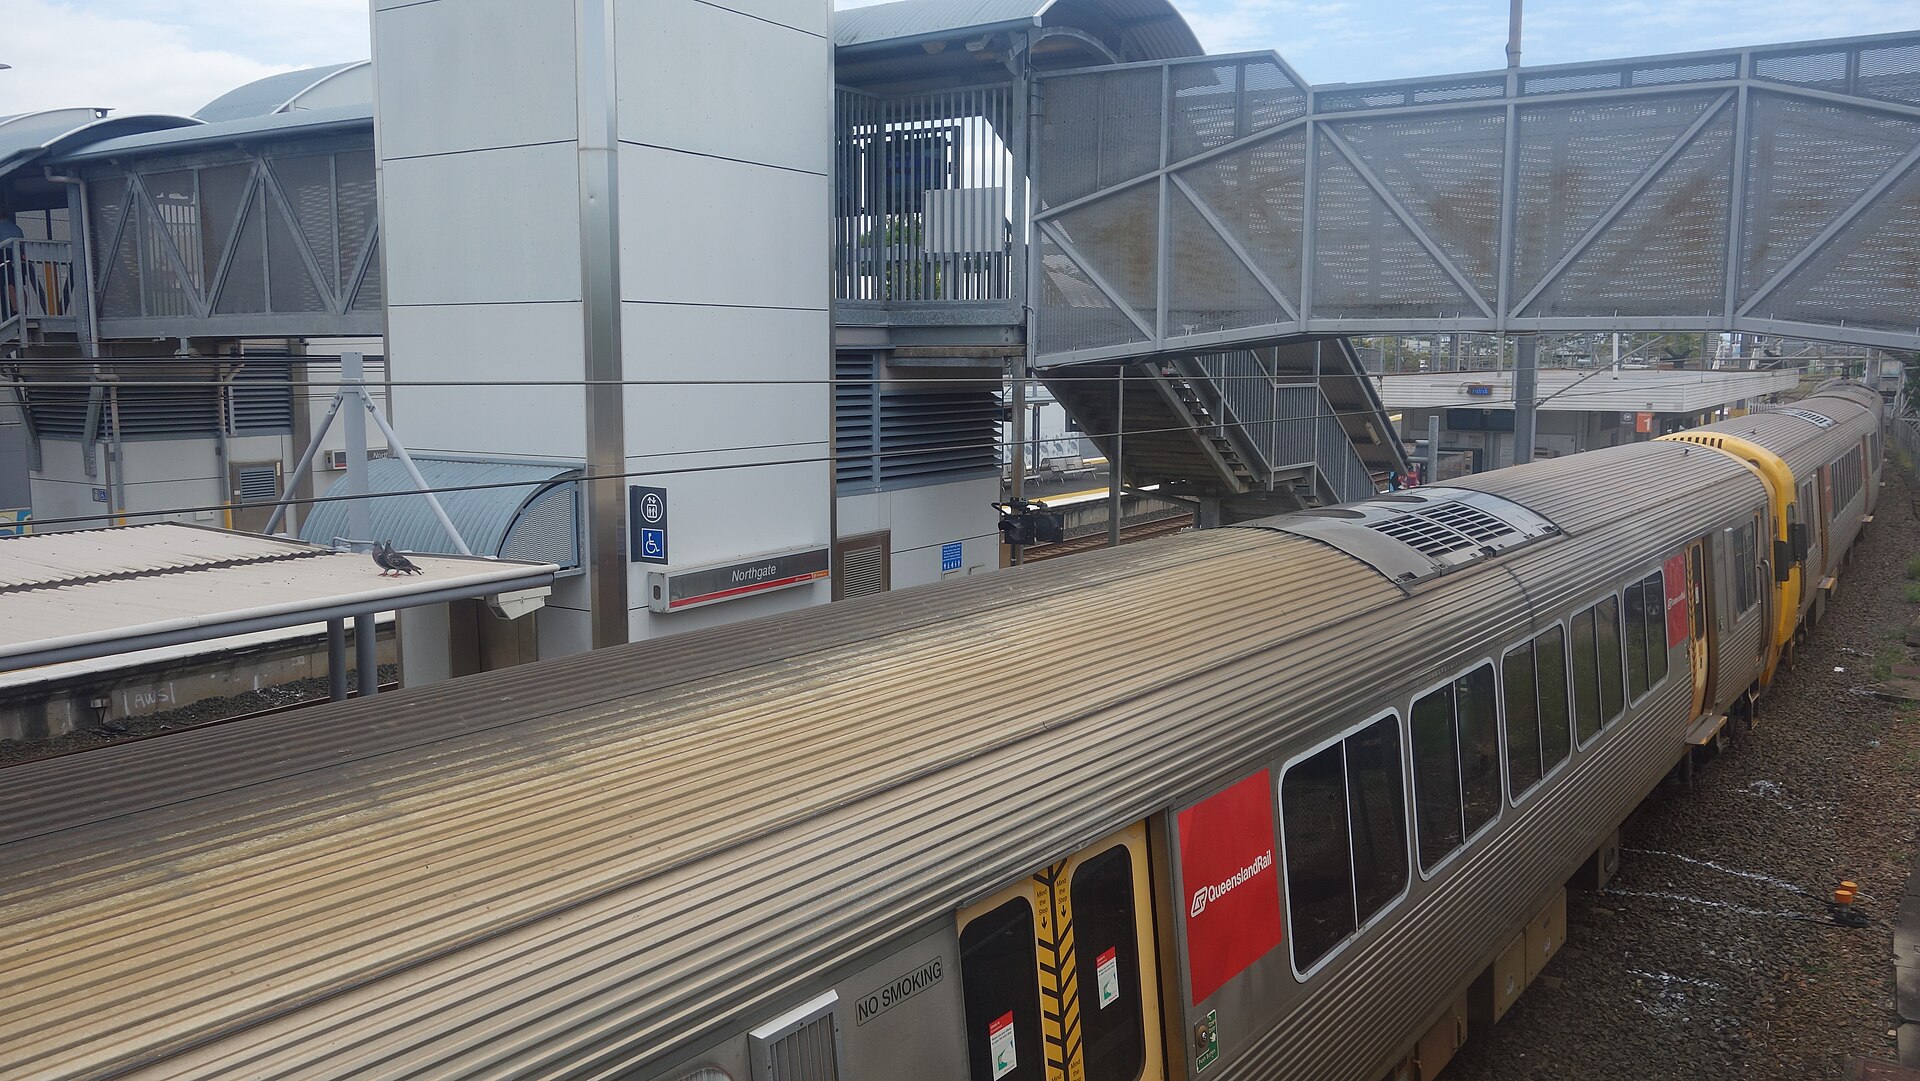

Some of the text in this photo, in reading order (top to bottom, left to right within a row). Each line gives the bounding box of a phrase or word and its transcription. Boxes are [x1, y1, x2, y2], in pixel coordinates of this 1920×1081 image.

[1643, 418, 1651, 431] 1
[731, 564, 777, 582] Northgate
[1208, 849, 1272, 902] QueenslandRail
[1056, 878, 1066, 887] Mind
[1036, 889, 1047, 897] Mind
[858, 961, 941, 1021] NO SMOKING
[1070, 1058, 1081, 1069] Mind
